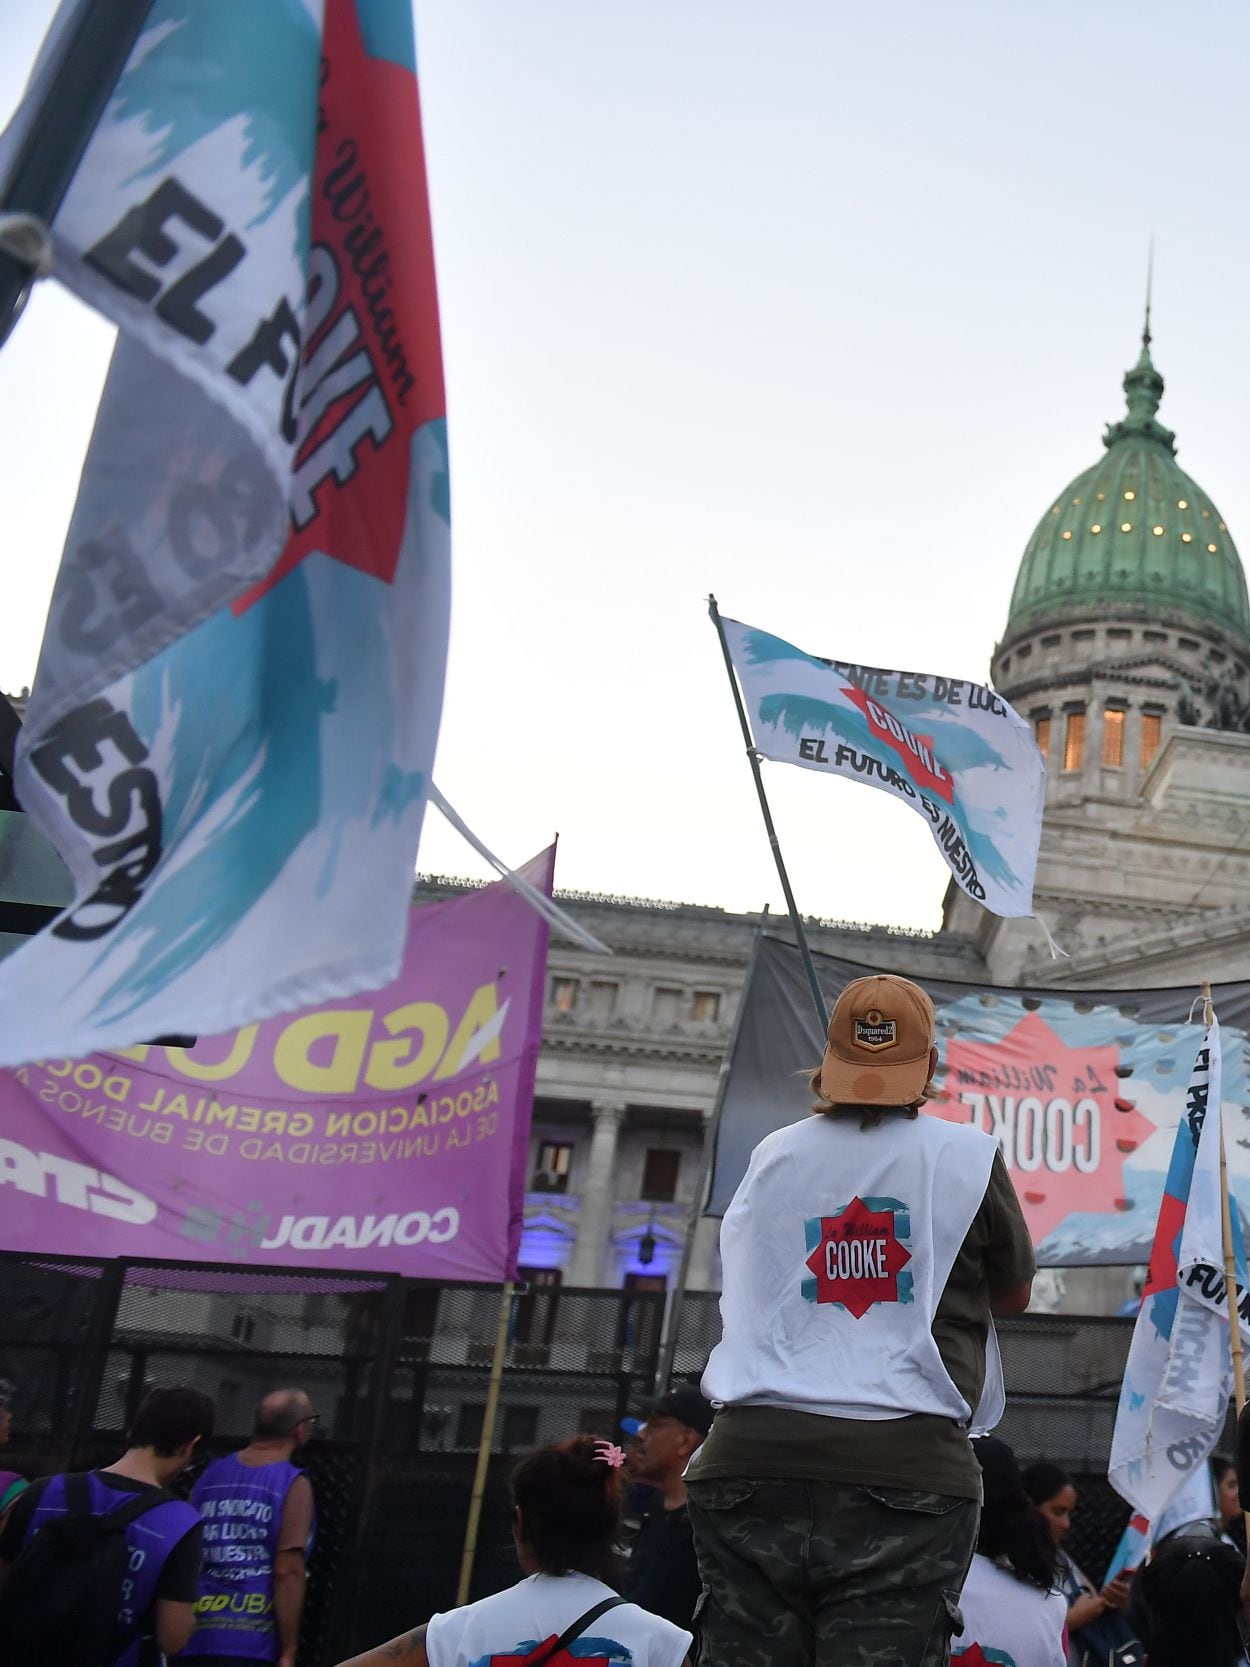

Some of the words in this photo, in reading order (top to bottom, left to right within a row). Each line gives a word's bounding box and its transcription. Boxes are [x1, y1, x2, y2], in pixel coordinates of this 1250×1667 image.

[83, 175, 247, 345] EL
[322, 138, 415, 406] William
[895, 672, 927, 700] ES
[933, 677, 964, 705] DE
[800, 738, 829, 764] EL
[835, 743, 917, 798] FUTURO
[920, 793, 941, 824] ES
[937, 815, 988, 902] NUESTRO
[857, 1024, 894, 1036] Dsquared2
[825, 1239, 889, 1280] COOKE
